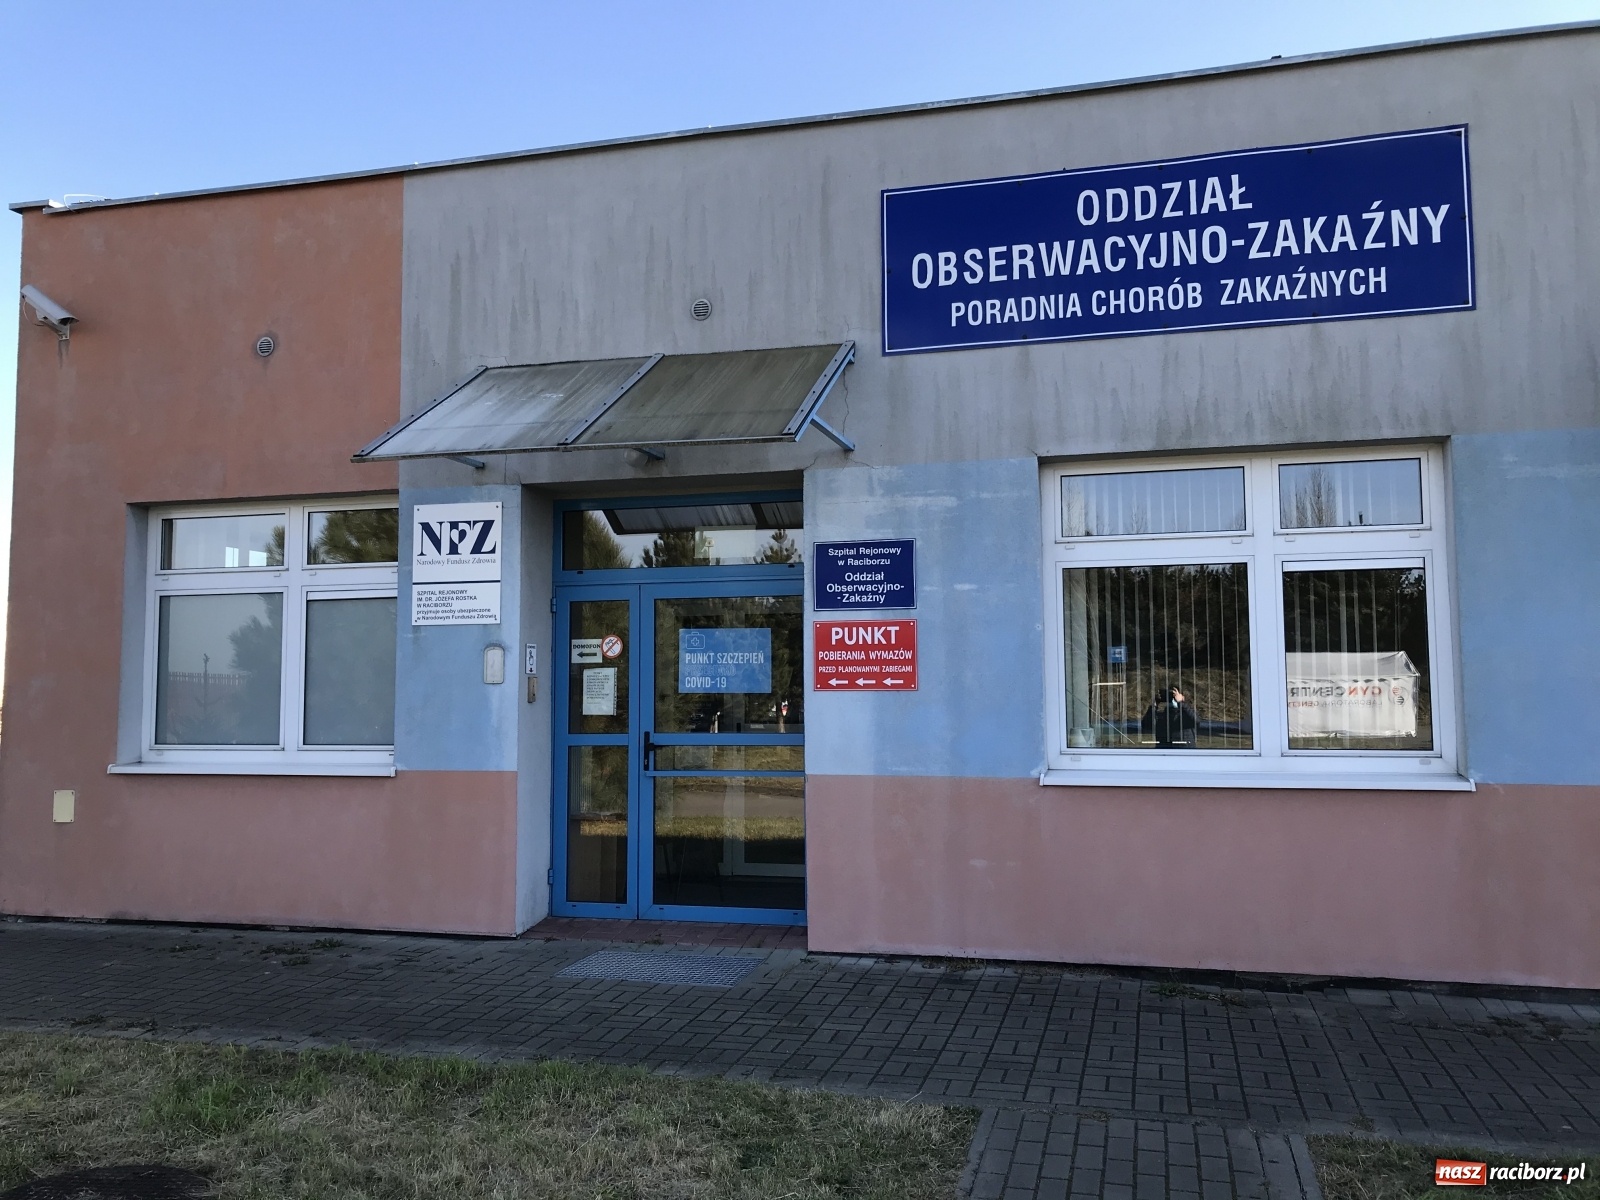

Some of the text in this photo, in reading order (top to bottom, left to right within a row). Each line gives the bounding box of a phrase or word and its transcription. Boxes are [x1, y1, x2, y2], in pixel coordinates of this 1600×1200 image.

[1076, 173, 1254, 227] ODDZIAŁ
[911, 200, 1452, 291] OBSERWACYJNO-ZAKAŹNY
[950, 265, 1388, 327] PORADNIA CHORÓB ZAKAŹNYCH
[417, 519, 497, 557] NFZ
[828, 547, 902, 558] Szpital Rejonowy
[416, 557, 497, 567] Narodowy Fundusz Zdrowia
[847, 558, 891, 566] Raciborzu
[844, 571, 885, 582] Oddział
[826, 582, 905, 594] Obserwacyjno-
[831, 626, 900, 646] PUNKT
[685, 650, 765, 664] PUNKT SZCZEPIEŃ
[818, 648, 913, 661] POBIERANIA WYMAZÓW
[838, 665, 880, 673] PLANOWANYMI
[881, 665, 913, 673] ZABIEGAMI
[685, 676, 727, 688] COVID-19
